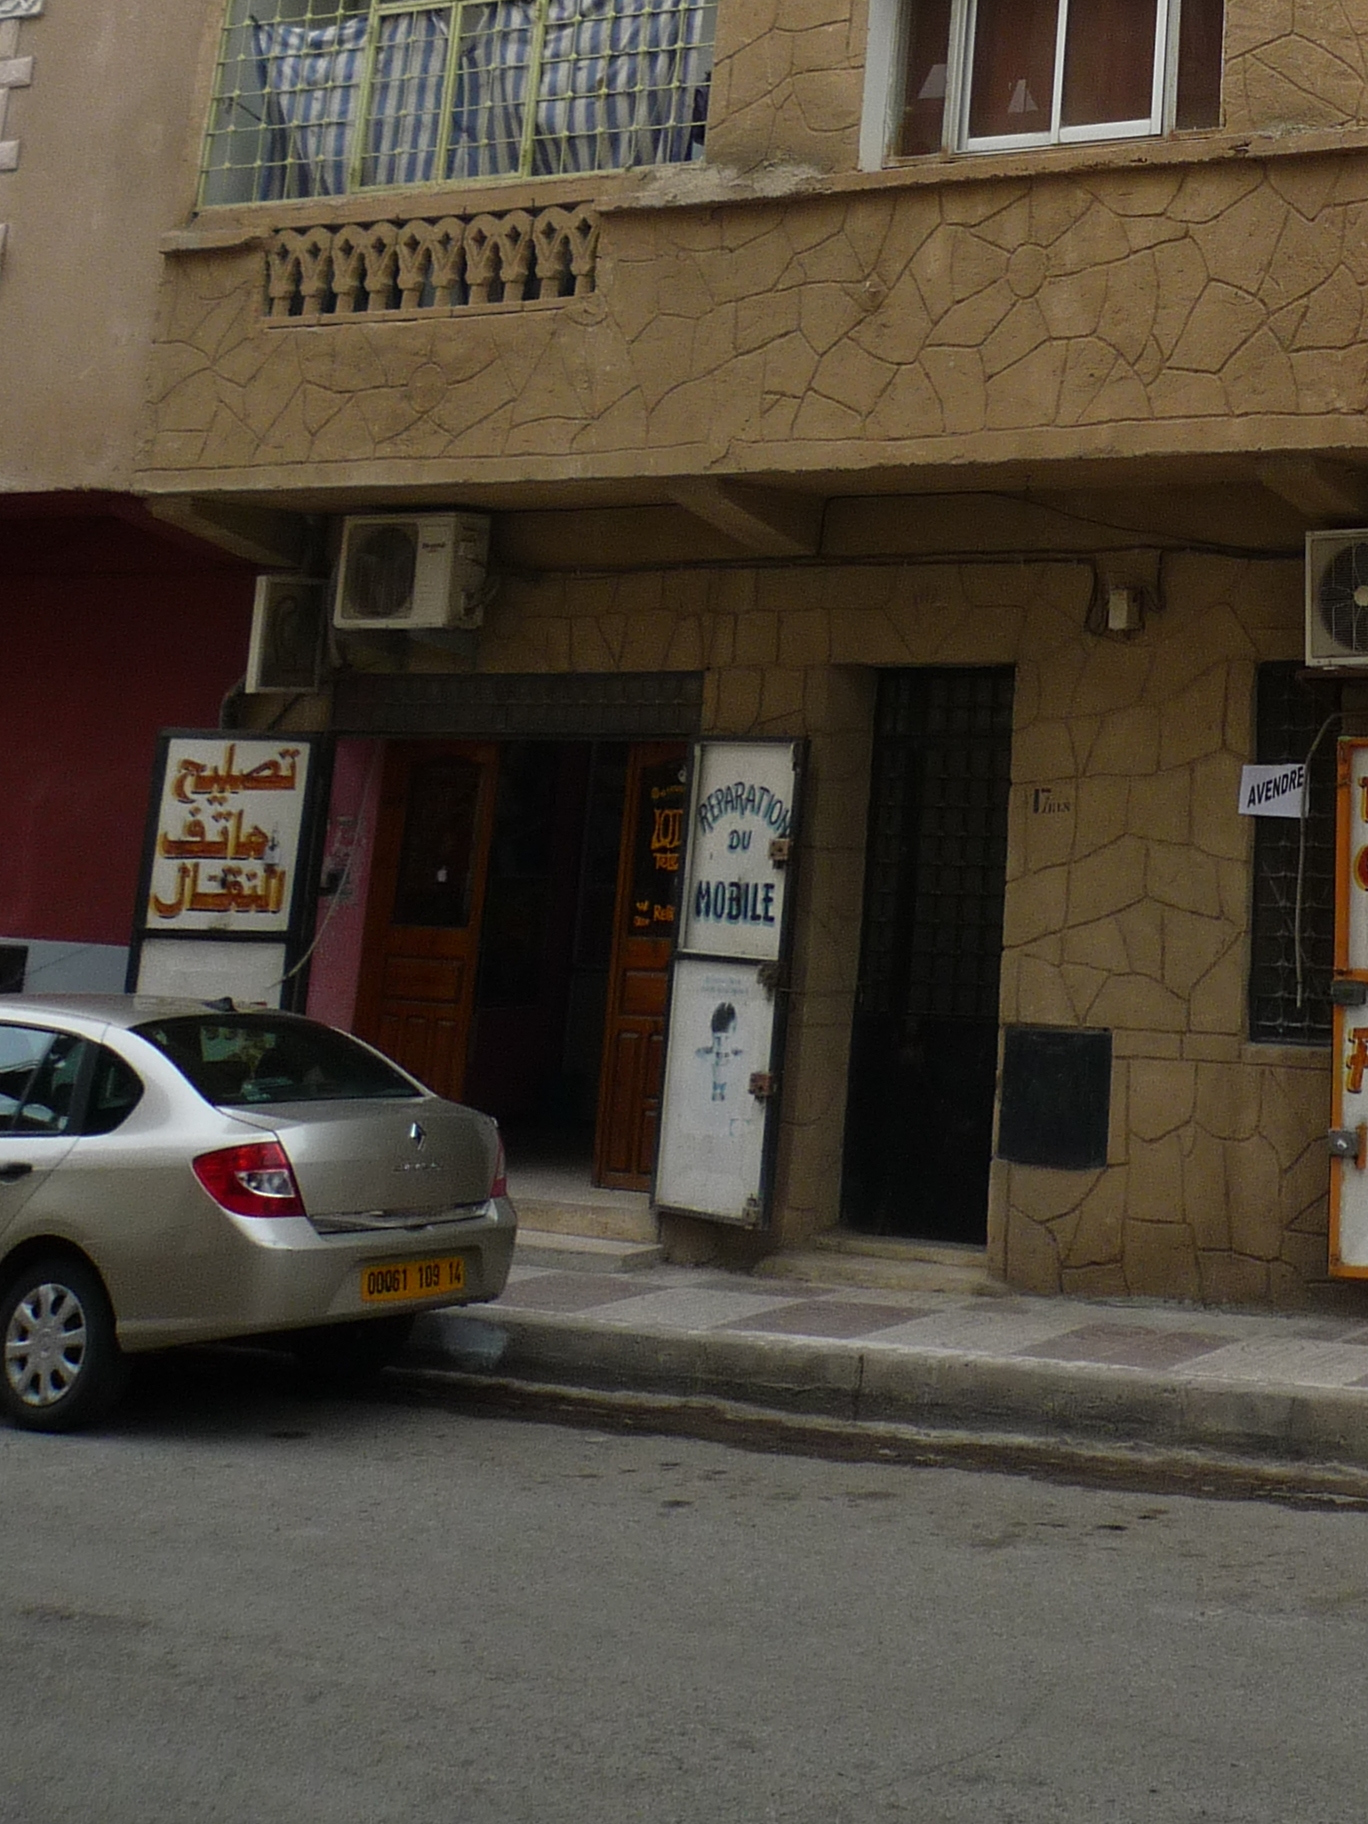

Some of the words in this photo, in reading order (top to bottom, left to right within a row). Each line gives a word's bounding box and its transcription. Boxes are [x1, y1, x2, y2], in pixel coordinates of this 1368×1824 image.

[171, 743, 301, 806] تصليح
[158, 805, 270, 861] هاتف
[699, 781, 791, 837] REPARATION
[727, 829, 753, 853] DU
[694, 880, 776, 925] MOBILE
